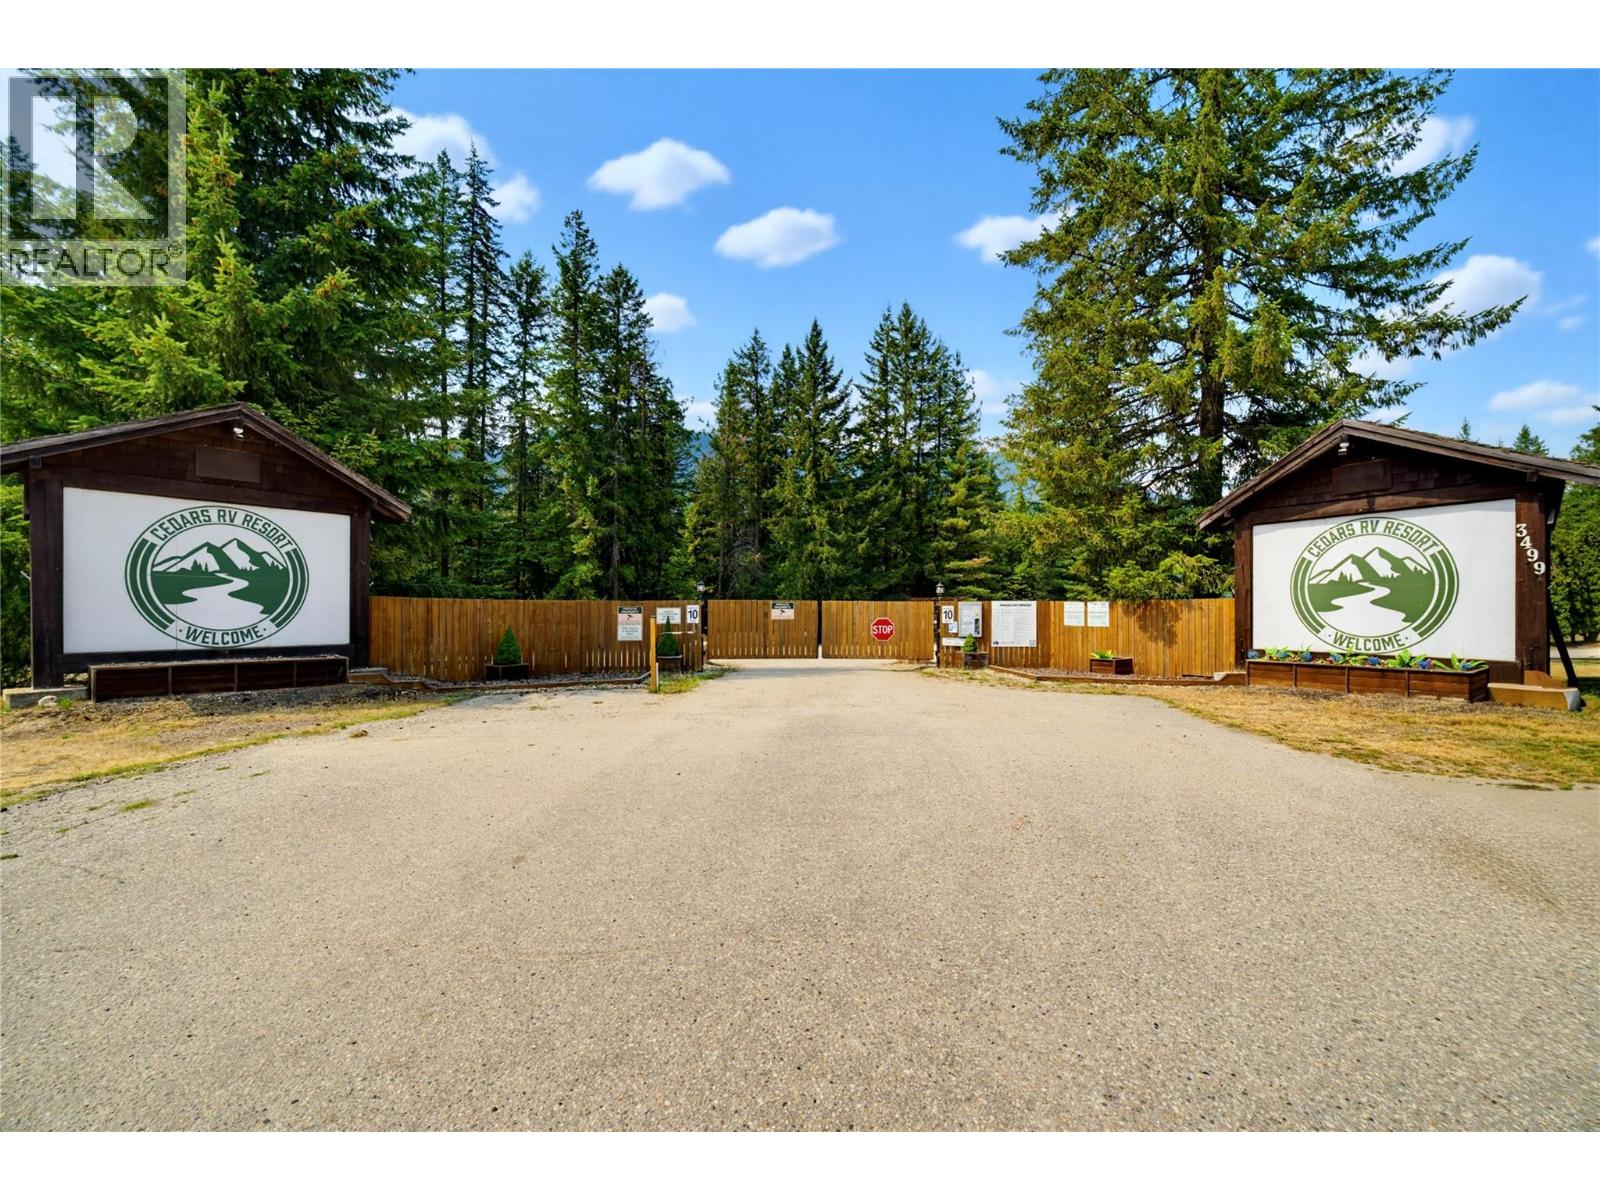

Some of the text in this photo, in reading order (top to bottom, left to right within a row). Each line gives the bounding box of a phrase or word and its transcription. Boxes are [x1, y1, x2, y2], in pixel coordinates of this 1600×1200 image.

[150, 509, 293, 552] CEDARS RV RESORT
[1307, 519, 1441, 558] CEDARS RV RESORT
[1516, 523, 1546, 575] 3499
[688, 609, 698, 620] 10
[943, 609, 953, 620] 10
[185, 625, 264, 646] WELCOME
[872, 625, 894, 634] STOP
[1331, 632, 1406, 651] WELCOME
